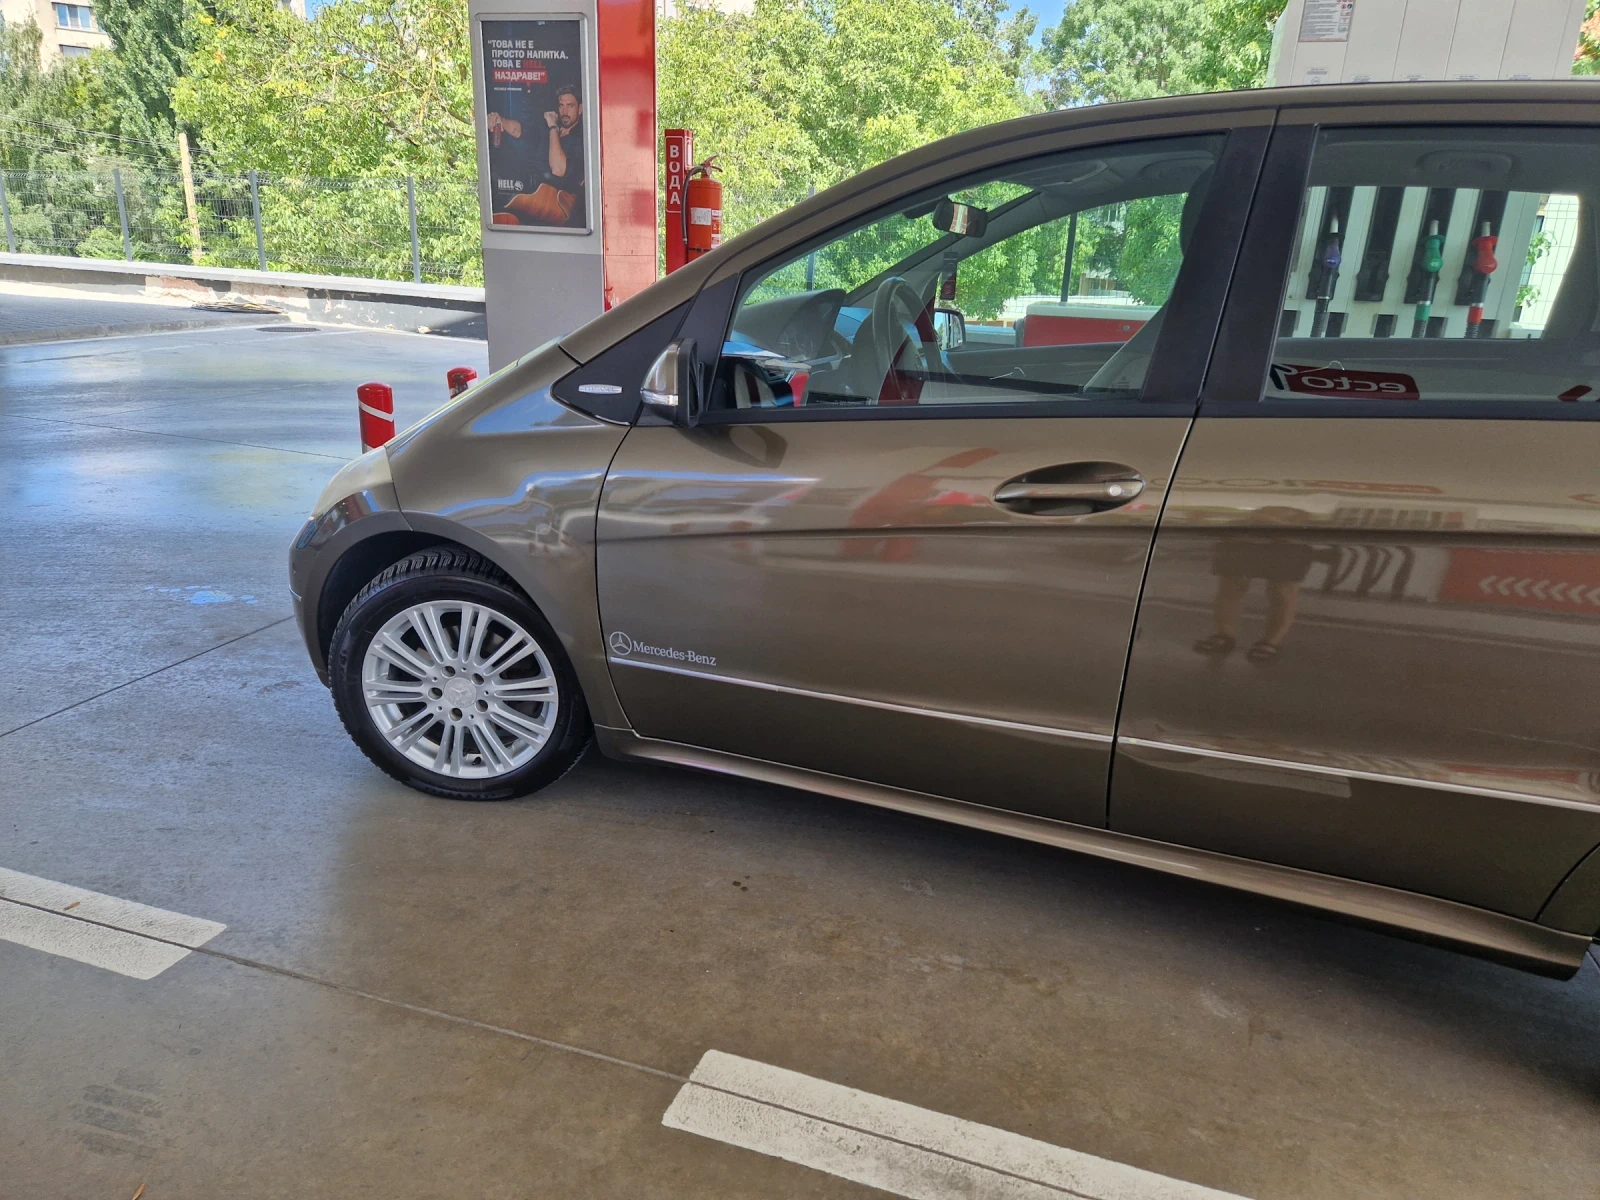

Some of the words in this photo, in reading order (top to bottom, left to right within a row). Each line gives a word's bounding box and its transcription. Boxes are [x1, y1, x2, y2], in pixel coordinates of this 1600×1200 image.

[515, 40, 527, 49] НЕ
[528, 40, 534, 49] Е
[491, 49, 525, 59] ПРОСТО
[526, 50, 569, 60] НАПИТКА.
[492, 59, 514, 68] ТОВА
[515, 60, 522, 68] Е
[669, 145, 681, 205] ВОДА
[497, 179, 514, 189] HELL
[633, 640, 717, 666] Mercedes-Benz
